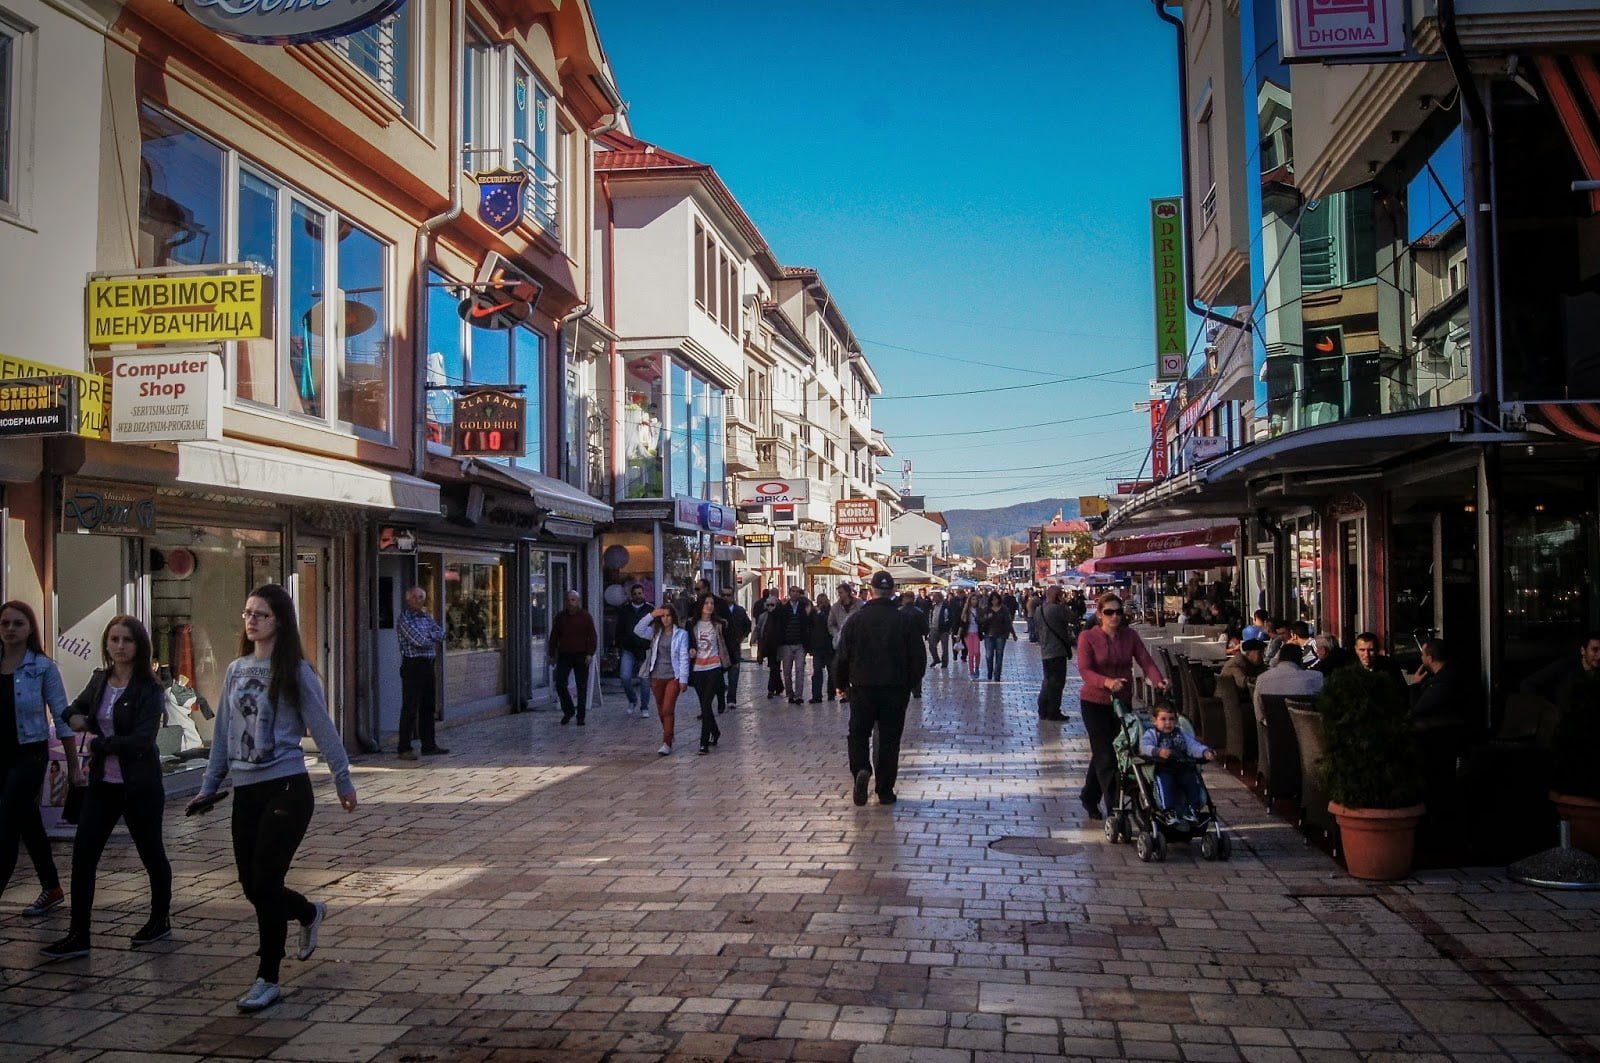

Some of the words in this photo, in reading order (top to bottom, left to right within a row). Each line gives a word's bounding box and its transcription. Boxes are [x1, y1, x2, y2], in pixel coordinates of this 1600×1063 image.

[1309, 27, 1375, 42] DHOMA
[96, 280, 255, 308] KEMBIMORE
[1161, 222, 1178, 350] DREDHEZA
[95, 312, 254, 337] МЕНУВАЧНИЦА
[116, 360, 208, 379] Computer
[139, 382, 186, 399] Shop
[0, 396, 48, 411] UNION
[460, 394, 518, 409] ZLATARA
[25, 416, 36, 425] НА
[37, 415, 59, 424] ПАРИ
[839, 507, 876, 518] KORÇA
